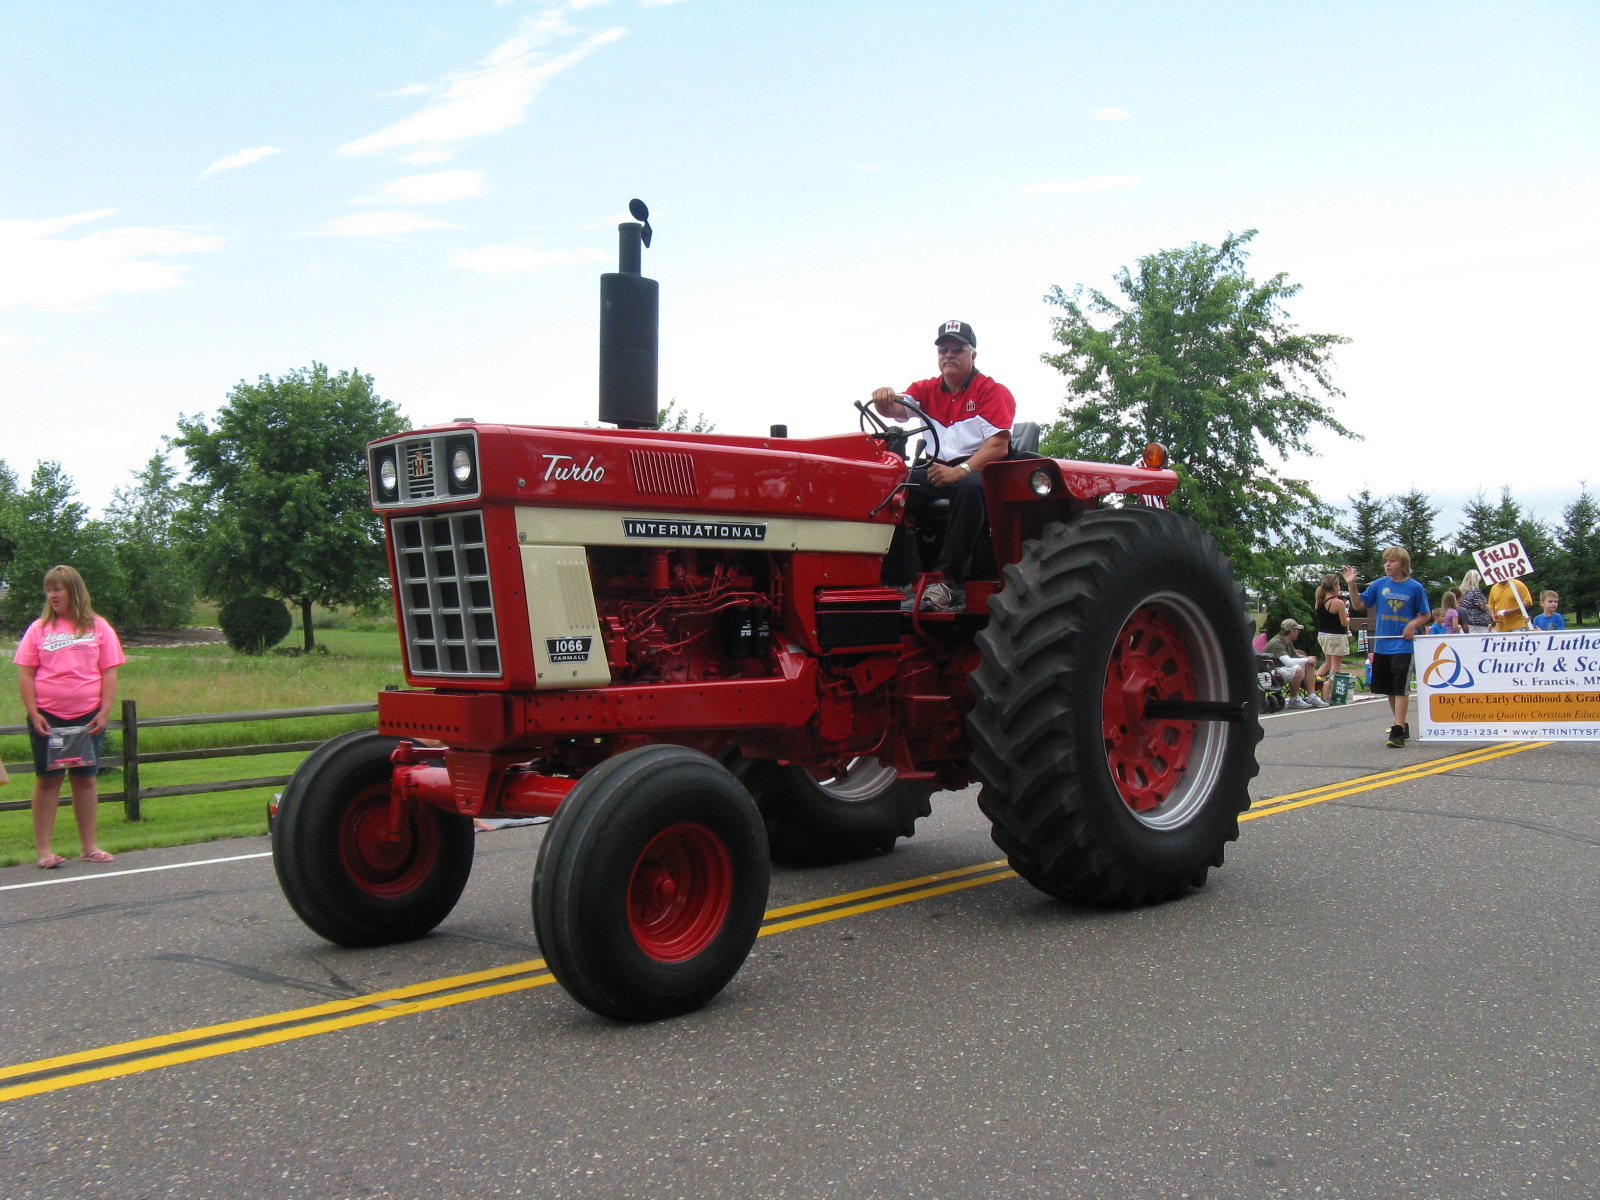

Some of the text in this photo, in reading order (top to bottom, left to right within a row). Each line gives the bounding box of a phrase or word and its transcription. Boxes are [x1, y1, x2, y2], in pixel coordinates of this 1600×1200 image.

[541, 454, 605, 483] Turbo
[628, 522, 763, 539] INTERNATIONAL
[1477, 542, 1519, 568] FIELD
[1482, 558, 1526, 584] TRIPS
[50, 641, 74, 650] SPORTS
[555, 639, 583, 653] 1066
[1481, 636, 1540, 656] Trinity
[1478, 655, 1600, 674] Church & Sc
[1512, 677, 1527, 686] St.
[1532, 676, 1579, 687] Francis,
[1439, 695, 1455, 706] Day
[1485, 695, 1510, 706] Early
[1513, 694, 1561, 703] Childhood
[1564, 693, 1573, 703] &
[1451, 711, 1486, 721] Offering
[1496, 710, 1529, 721] Quality
[1530, 710, 1571, 719] Christian
[1426, 728, 1499, 736] 763-753-1234
